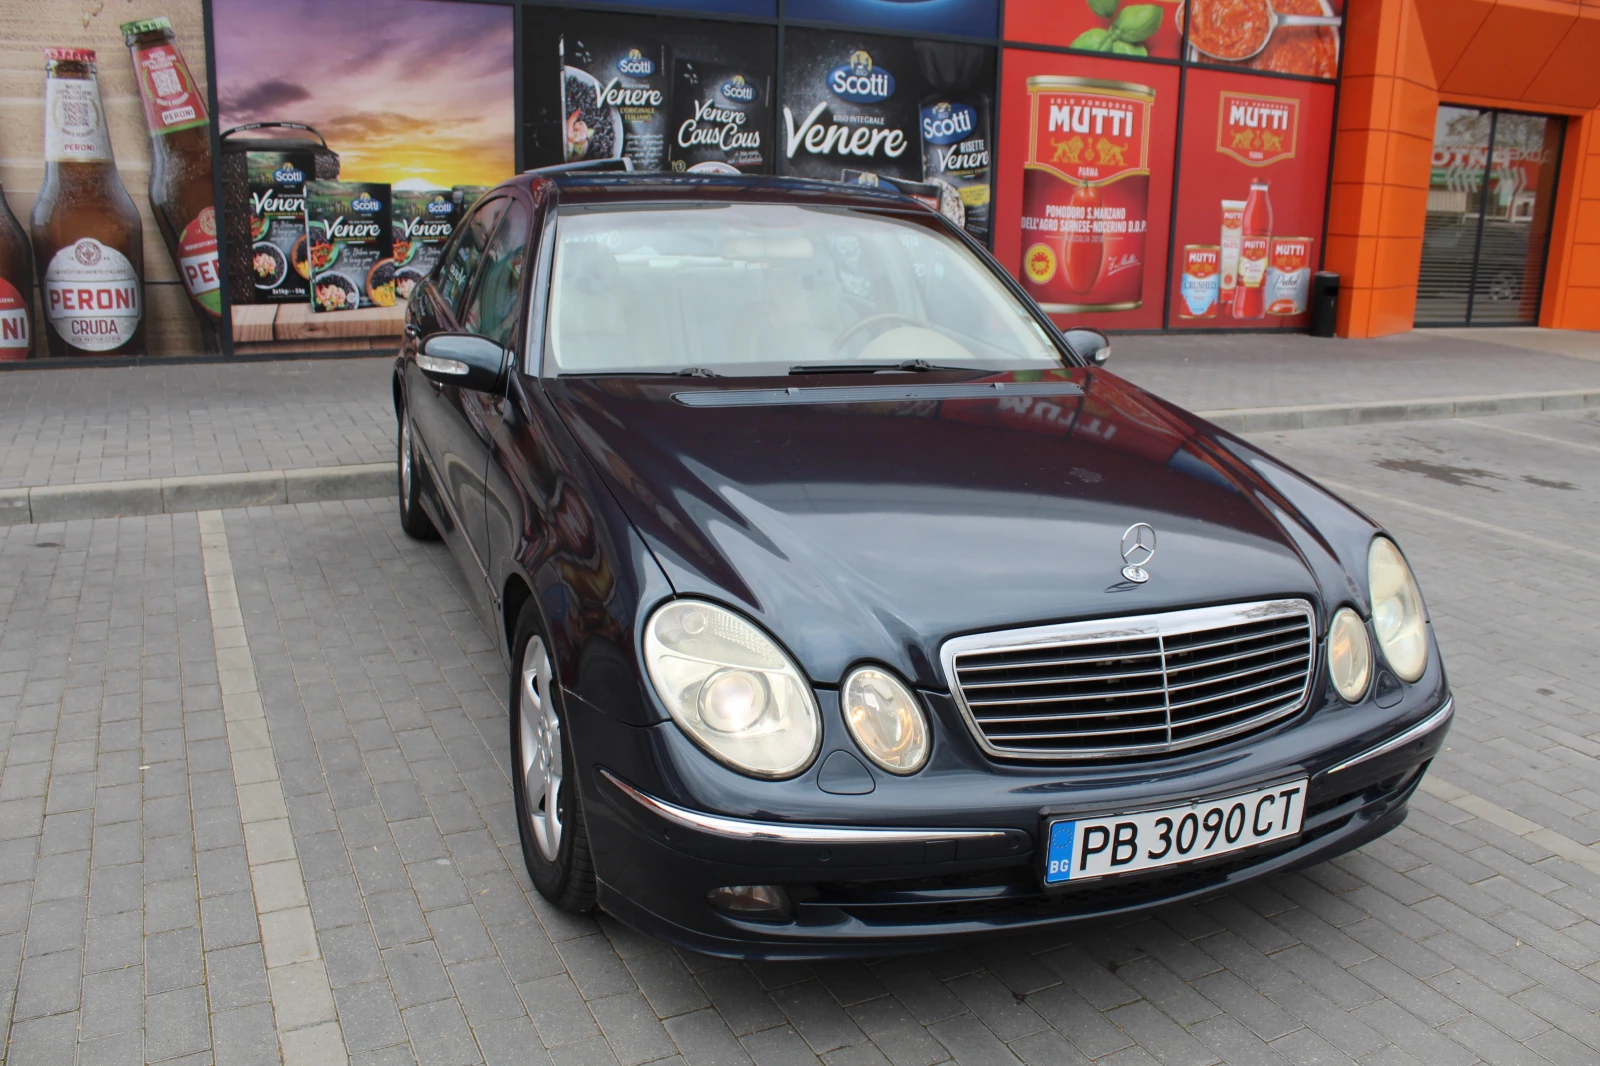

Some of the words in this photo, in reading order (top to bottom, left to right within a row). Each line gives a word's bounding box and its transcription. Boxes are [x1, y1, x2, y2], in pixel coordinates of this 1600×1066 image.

[620, 60, 651, 73] Scotti
[832, 70, 889, 97] Scotti
[594, 77, 663, 108] Venere
[724, 84, 753, 100] Scotti
[694, 99, 747, 125] Venere
[1081, 99, 1133, 110] POMODORO
[164, 110, 194, 122] PERONI
[833, 114, 849, 122] RISO
[850, 115, 885, 125] INTEGRALE
[1048, 104, 1134, 138] MUTTI
[1229, 104, 1289, 131] MUTTI
[783, 101, 908, 159] Venere
[923, 110, 972, 139] Scotti
[64, 143, 95, 151] PERONI
[960, 139, 985, 153] RISETTE
[275, 171, 303, 181] Scotti
[1078, 167, 1098, 177] PARMA
[253, 189, 306, 214] Vener
[352, 202, 379, 211] Scotti
[429, 203, 451, 213] Scotti
[1045, 204, 1085, 218] POMODORO
[1087, 207, 1126, 220] S.MARZANO
[324, 216, 381, 240] Venere
[403, 216, 453, 239] Venere
[1021, 217, 1059, 232] DELL'AGRO
[1060, 220, 1126, 233] SARNESE-NOCERINO
[1245, 240, 1266, 249] MUTTI
[1275, 244, 1304, 256] MUTTI
[1189, 253, 1216, 264] MUTTI
[1184, 280, 1217, 290] CRUSHED
[49, 287, 137, 311] PERONI
[71, 319, 118, 335] CRUDA
[1079, 821, 1138, 871] PB
[1147, 801, 1246, 860] 3090
[1251, 787, 1301, 837] CT
[1049, 859, 1069, 874] BG
